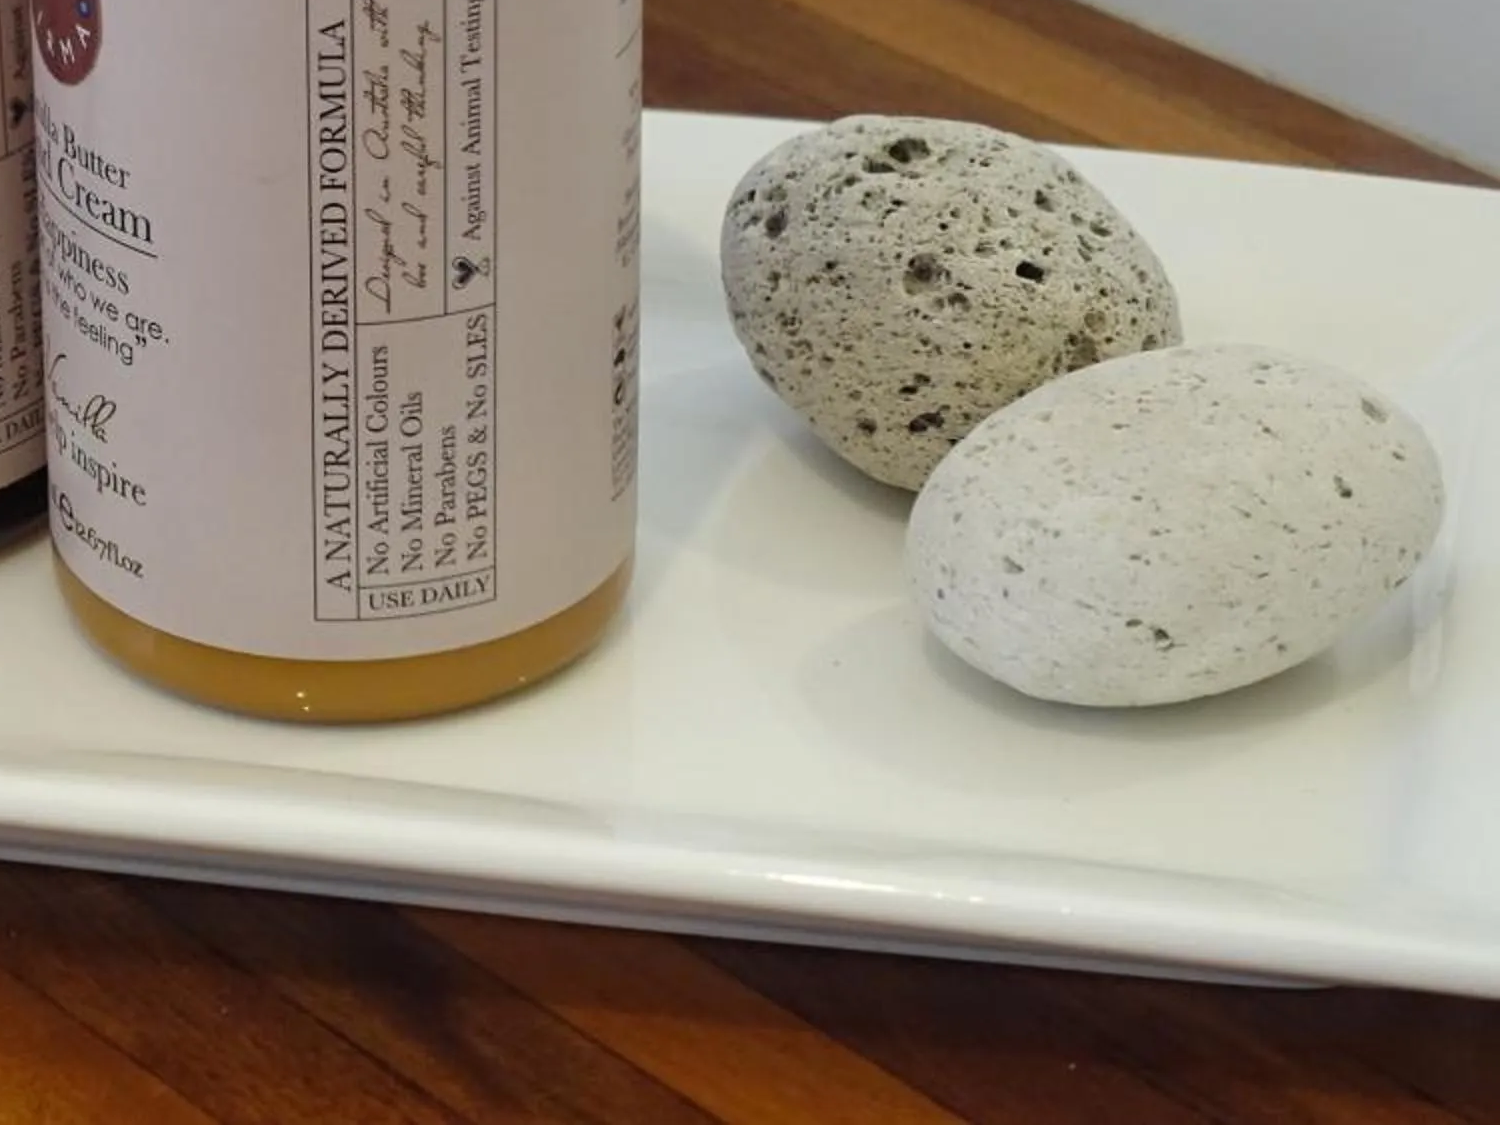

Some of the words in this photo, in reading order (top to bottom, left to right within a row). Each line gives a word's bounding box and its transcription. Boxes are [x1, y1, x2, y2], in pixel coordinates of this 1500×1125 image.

[316, 19, 348, 194] FORMULA
[399, 20, 442, 122] thinking
[361, 64, 390, 162] Australia
[459, 76, 483, 157] Animal
[62, 122, 131, 190] Butter
[379, 175, 391, 204] in
[399, 124, 444, 197] careful
[57, 156, 155, 245] Cream
[401, 201, 428, 249] and
[460, 161, 488, 242] Against
[319, 202, 350, 353] DERIVED
[363, 206, 407, 316] Designed
[7, 260, 28, 361] Parabens
[59, 263, 87, 301] who
[92, 289, 120, 322] we
[125, 311, 170, 345] are.
[13, 365, 29, 402] No
[466, 312, 488, 380] SLES
[364, 344, 390, 435] Colours
[399, 390, 424, 438] Oils
[466, 383, 488, 421] No
[71, 429, 148, 507] inspire
[322, 362, 352, 563] NATURALLY
[466, 424, 488, 445] &
[365, 438, 390, 536] Artificial
[400, 442, 424, 532] Mineral
[434, 424, 457, 528] Parabens
[466, 448, 488, 522] PEGS
[365, 540, 390, 578] No
[400, 536, 424, 573] No
[434, 531, 457, 570] No
[466, 524, 489, 563] No
[326, 571, 352, 593] A
[368, 590, 416, 613] USE
[420, 574, 491, 604] DAILY
